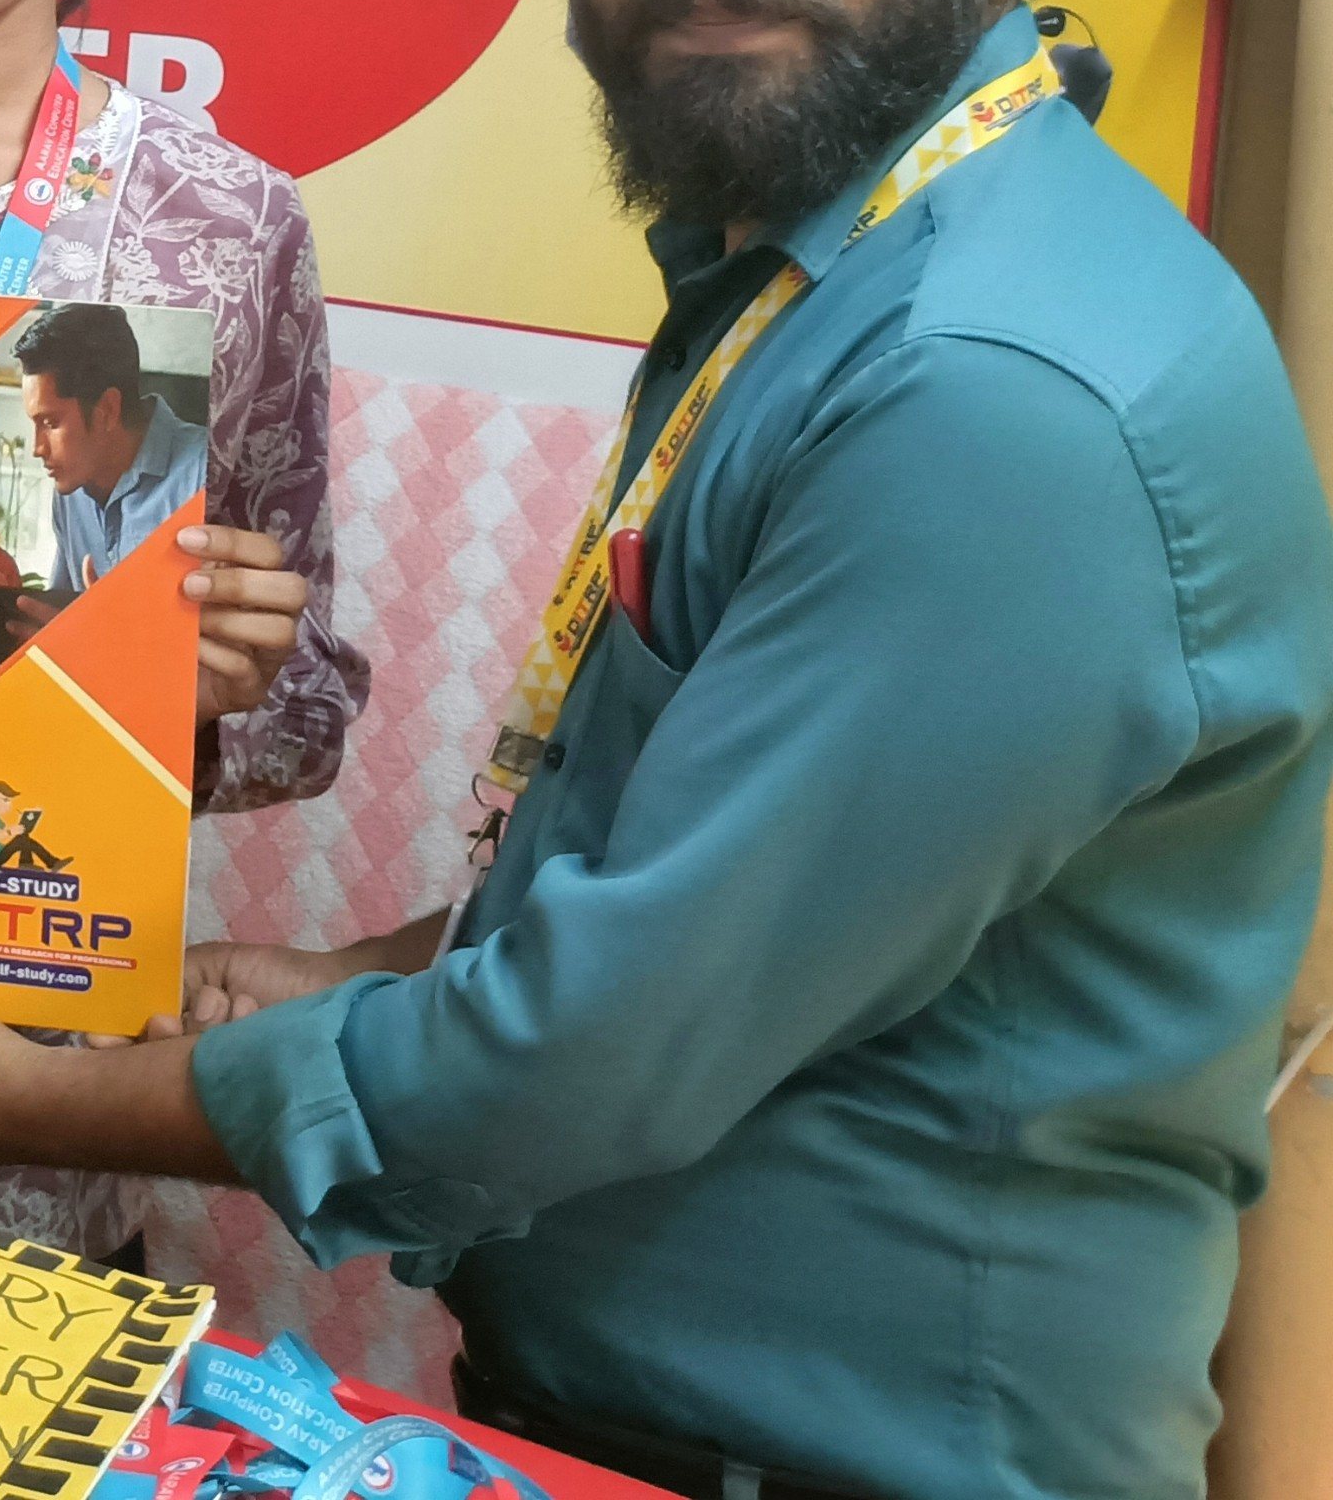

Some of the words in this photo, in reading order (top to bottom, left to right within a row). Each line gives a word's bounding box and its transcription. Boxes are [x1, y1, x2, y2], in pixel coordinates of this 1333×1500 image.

[10, 947, 55, 959] RESEARCH
[54, 952, 72, 961] FOR
[71, 953, 133, 968] PROFESSIONAL
[206, 1358, 265, 1394] CENTER
[202, 1380, 284, 1432] COMPUTER
